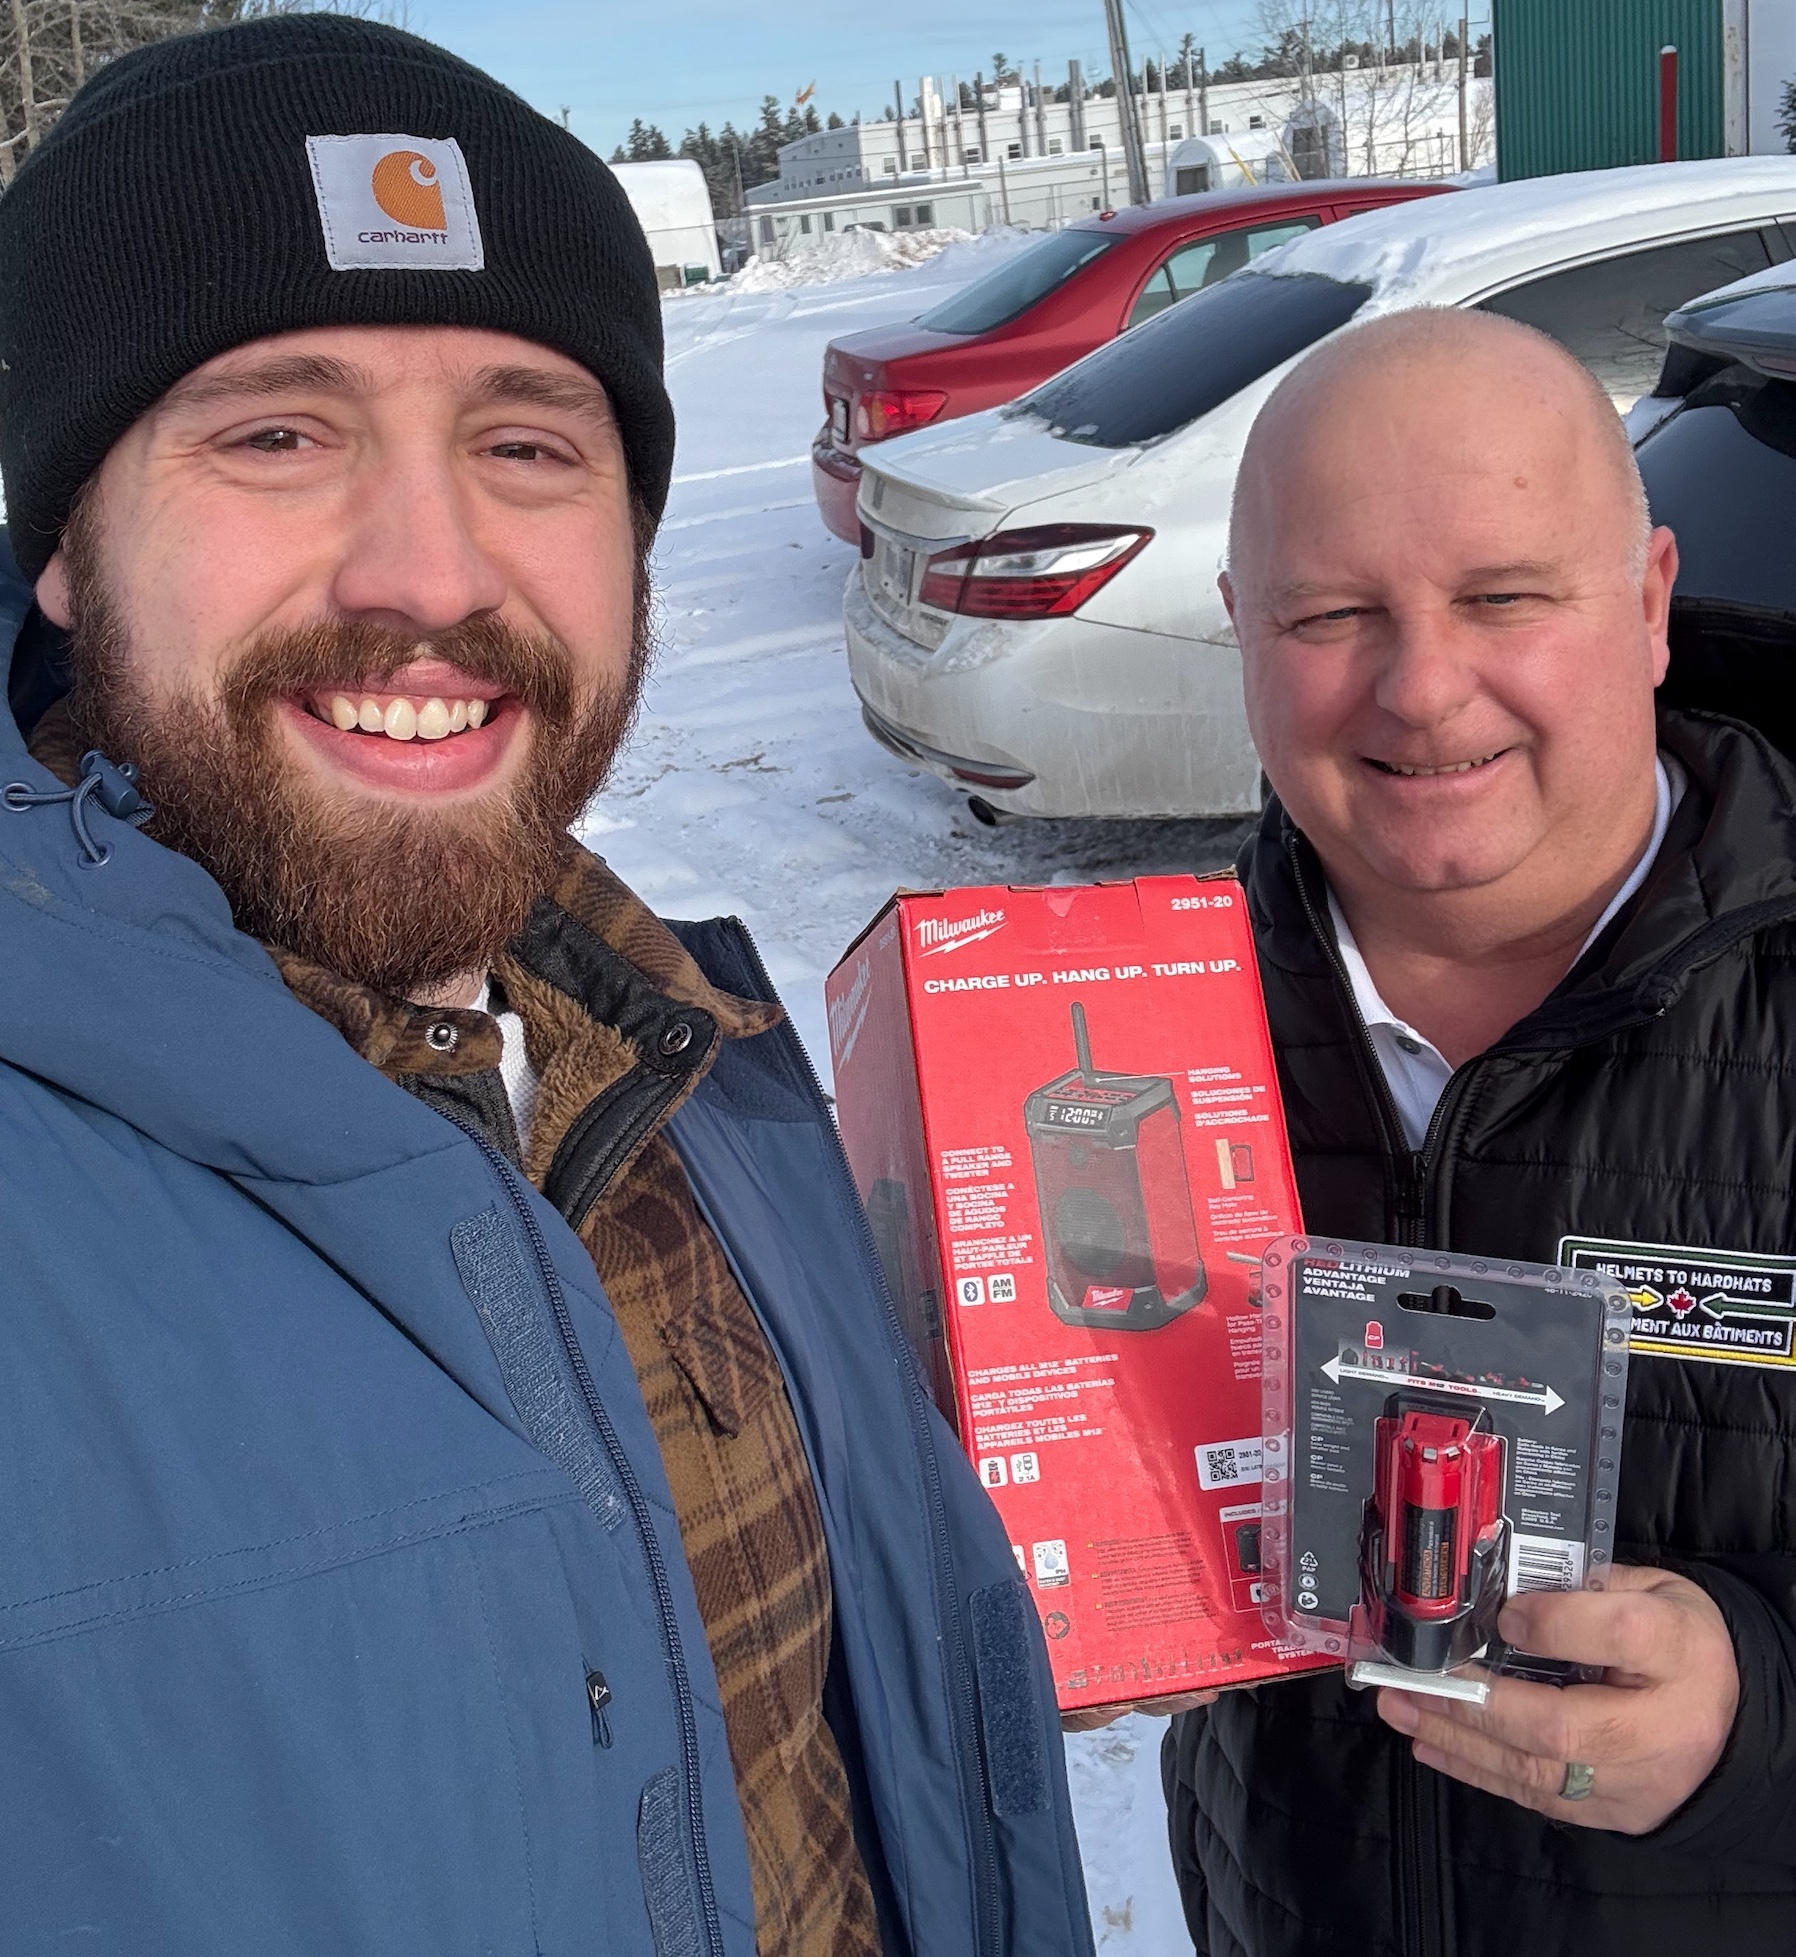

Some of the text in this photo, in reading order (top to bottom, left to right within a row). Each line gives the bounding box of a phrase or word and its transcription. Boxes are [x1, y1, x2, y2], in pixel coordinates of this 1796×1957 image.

[358, 230, 448, 244] carhartt
[1171, 895, 1233, 911] 2951-20
[913, 908, 1006, 948] Milwaukee
[923, 959, 1242, 994] CHARGE UP. HANG UP. TURN UP.
[1187, 1066, 1231, 1076] HANGING
[1188, 1072, 1242, 1083] SOLUTIONS
[1190, 1085, 1266, 1098] SOLUCIONES DE
[1194, 1109, 1248, 1120] SOLUTIONS
[941, 1146, 1005, 1158] CONNECT TO
[950, 1156, 975, 1164] FULL
[991, 1160, 1013, 1168] AND
[946, 1191, 1008, 1202] UNA BOCINA
[955, 1200, 995, 1209] BOCINA
[948, 1210, 962, 1218] DE
[949, 1217, 963, 1225] DE
[951, 1236, 1007, 1248] BRANCHEZ
[1017, 1234, 1032, 1242] UN
[1007, 1250, 1021, 1258] DE
[1303, 1267, 1386, 1285] ADVANTAGE
[1596, 1262, 1772, 1293] HELMETS TO HARDHATS
[992, 1279, 1011, 1288] AM
[1303, 1276, 1365, 1291] VENTAJA
[993, 1289, 1013, 1298] FM
[1303, 1286, 1375, 1302] AVANTAGE
[1630, 1318, 1783, 1346] MENT AUX BÂTIMENTS
[967, 1365, 1017, 1378] CHARGES
[1019, 1363, 1037, 1372] ALL
[1064, 1354, 1119, 1367] BATTERIES
[968, 1366, 1077, 1386] AND MOBILE DEVICES
[1407, 1378, 1426, 1386] FITS
[970, 1391, 1007, 1403] CARGA
[1008, 1386, 1043, 1398] TODAS
[1044, 1384, 1065, 1393] LAS
[1006, 1390, 1078, 1405] DISPOSITIVOS
[974, 1413, 1087, 1435] CHARGEZ TOUTES LES
[976, 1424, 1067, 1443] BATTERIES ET LES
[977, 1436, 1033, 1450] APPAREILS
[1035, 1430, 1080, 1443] MOBILES
[1224, 1509, 1256, 1518] INCLUDES
